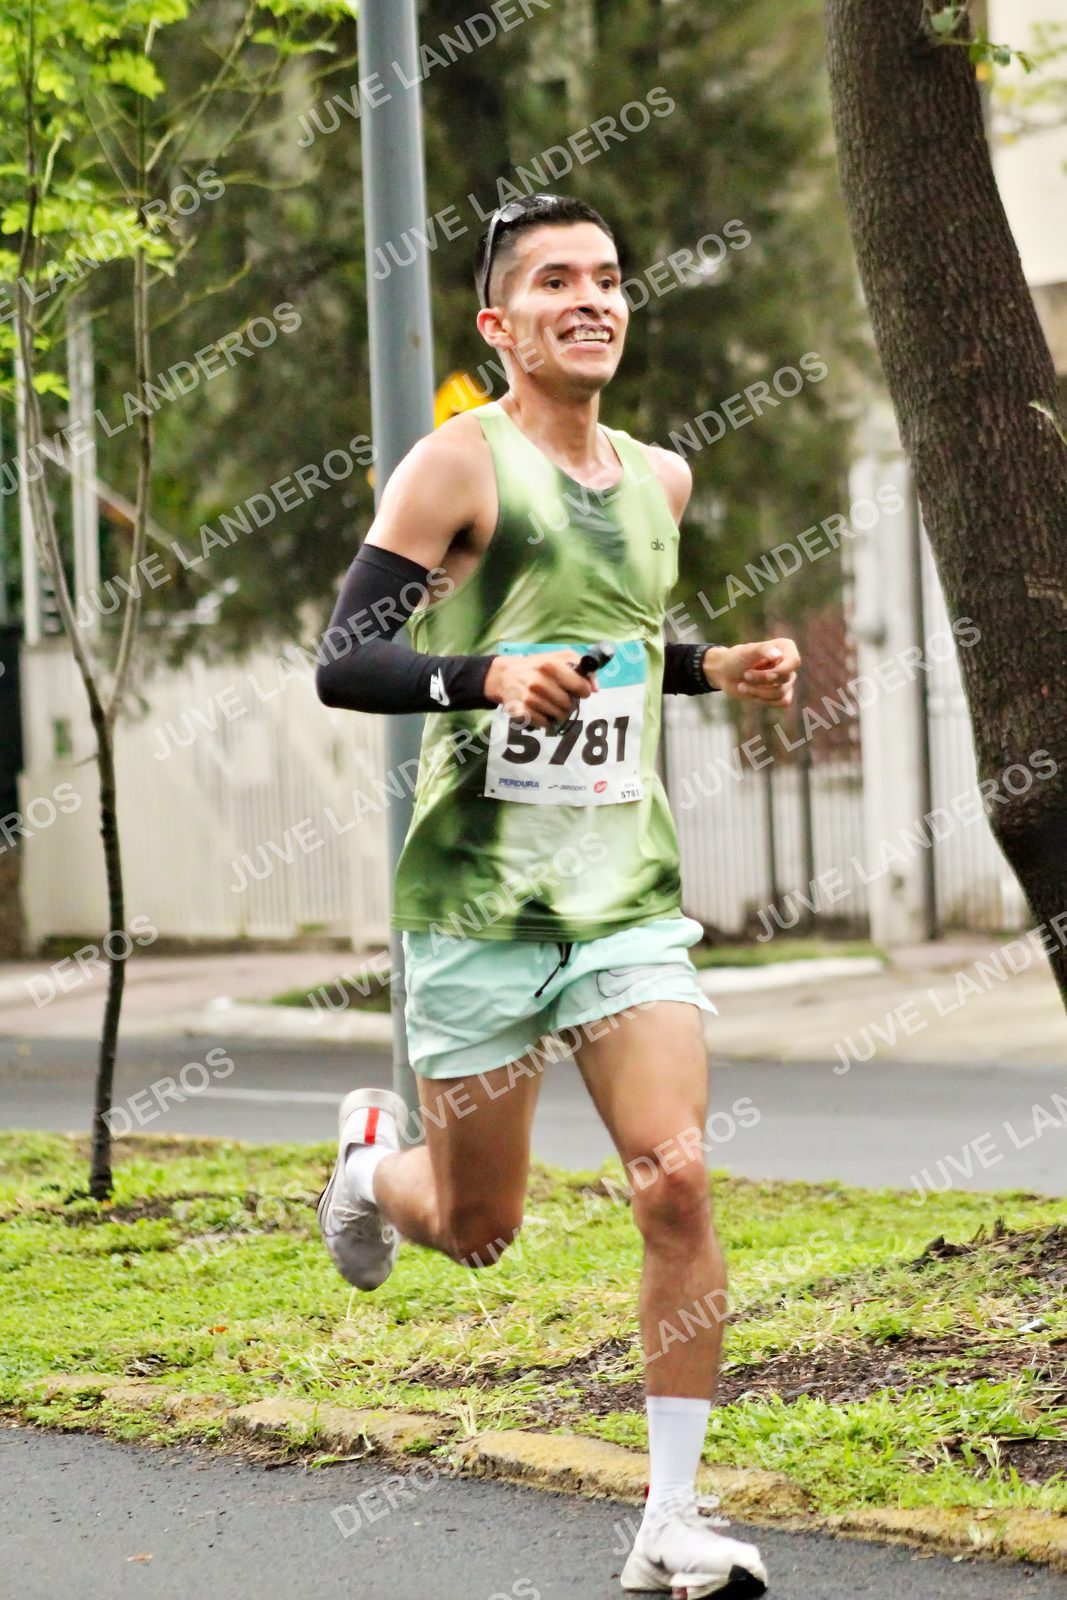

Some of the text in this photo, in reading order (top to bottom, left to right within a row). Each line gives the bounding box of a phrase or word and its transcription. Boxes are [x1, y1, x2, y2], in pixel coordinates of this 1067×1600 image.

[501, 716, 630, 765] 5781
[499, 778, 540, 788] PERDURA
[621, 790, 640, 798] 5781
